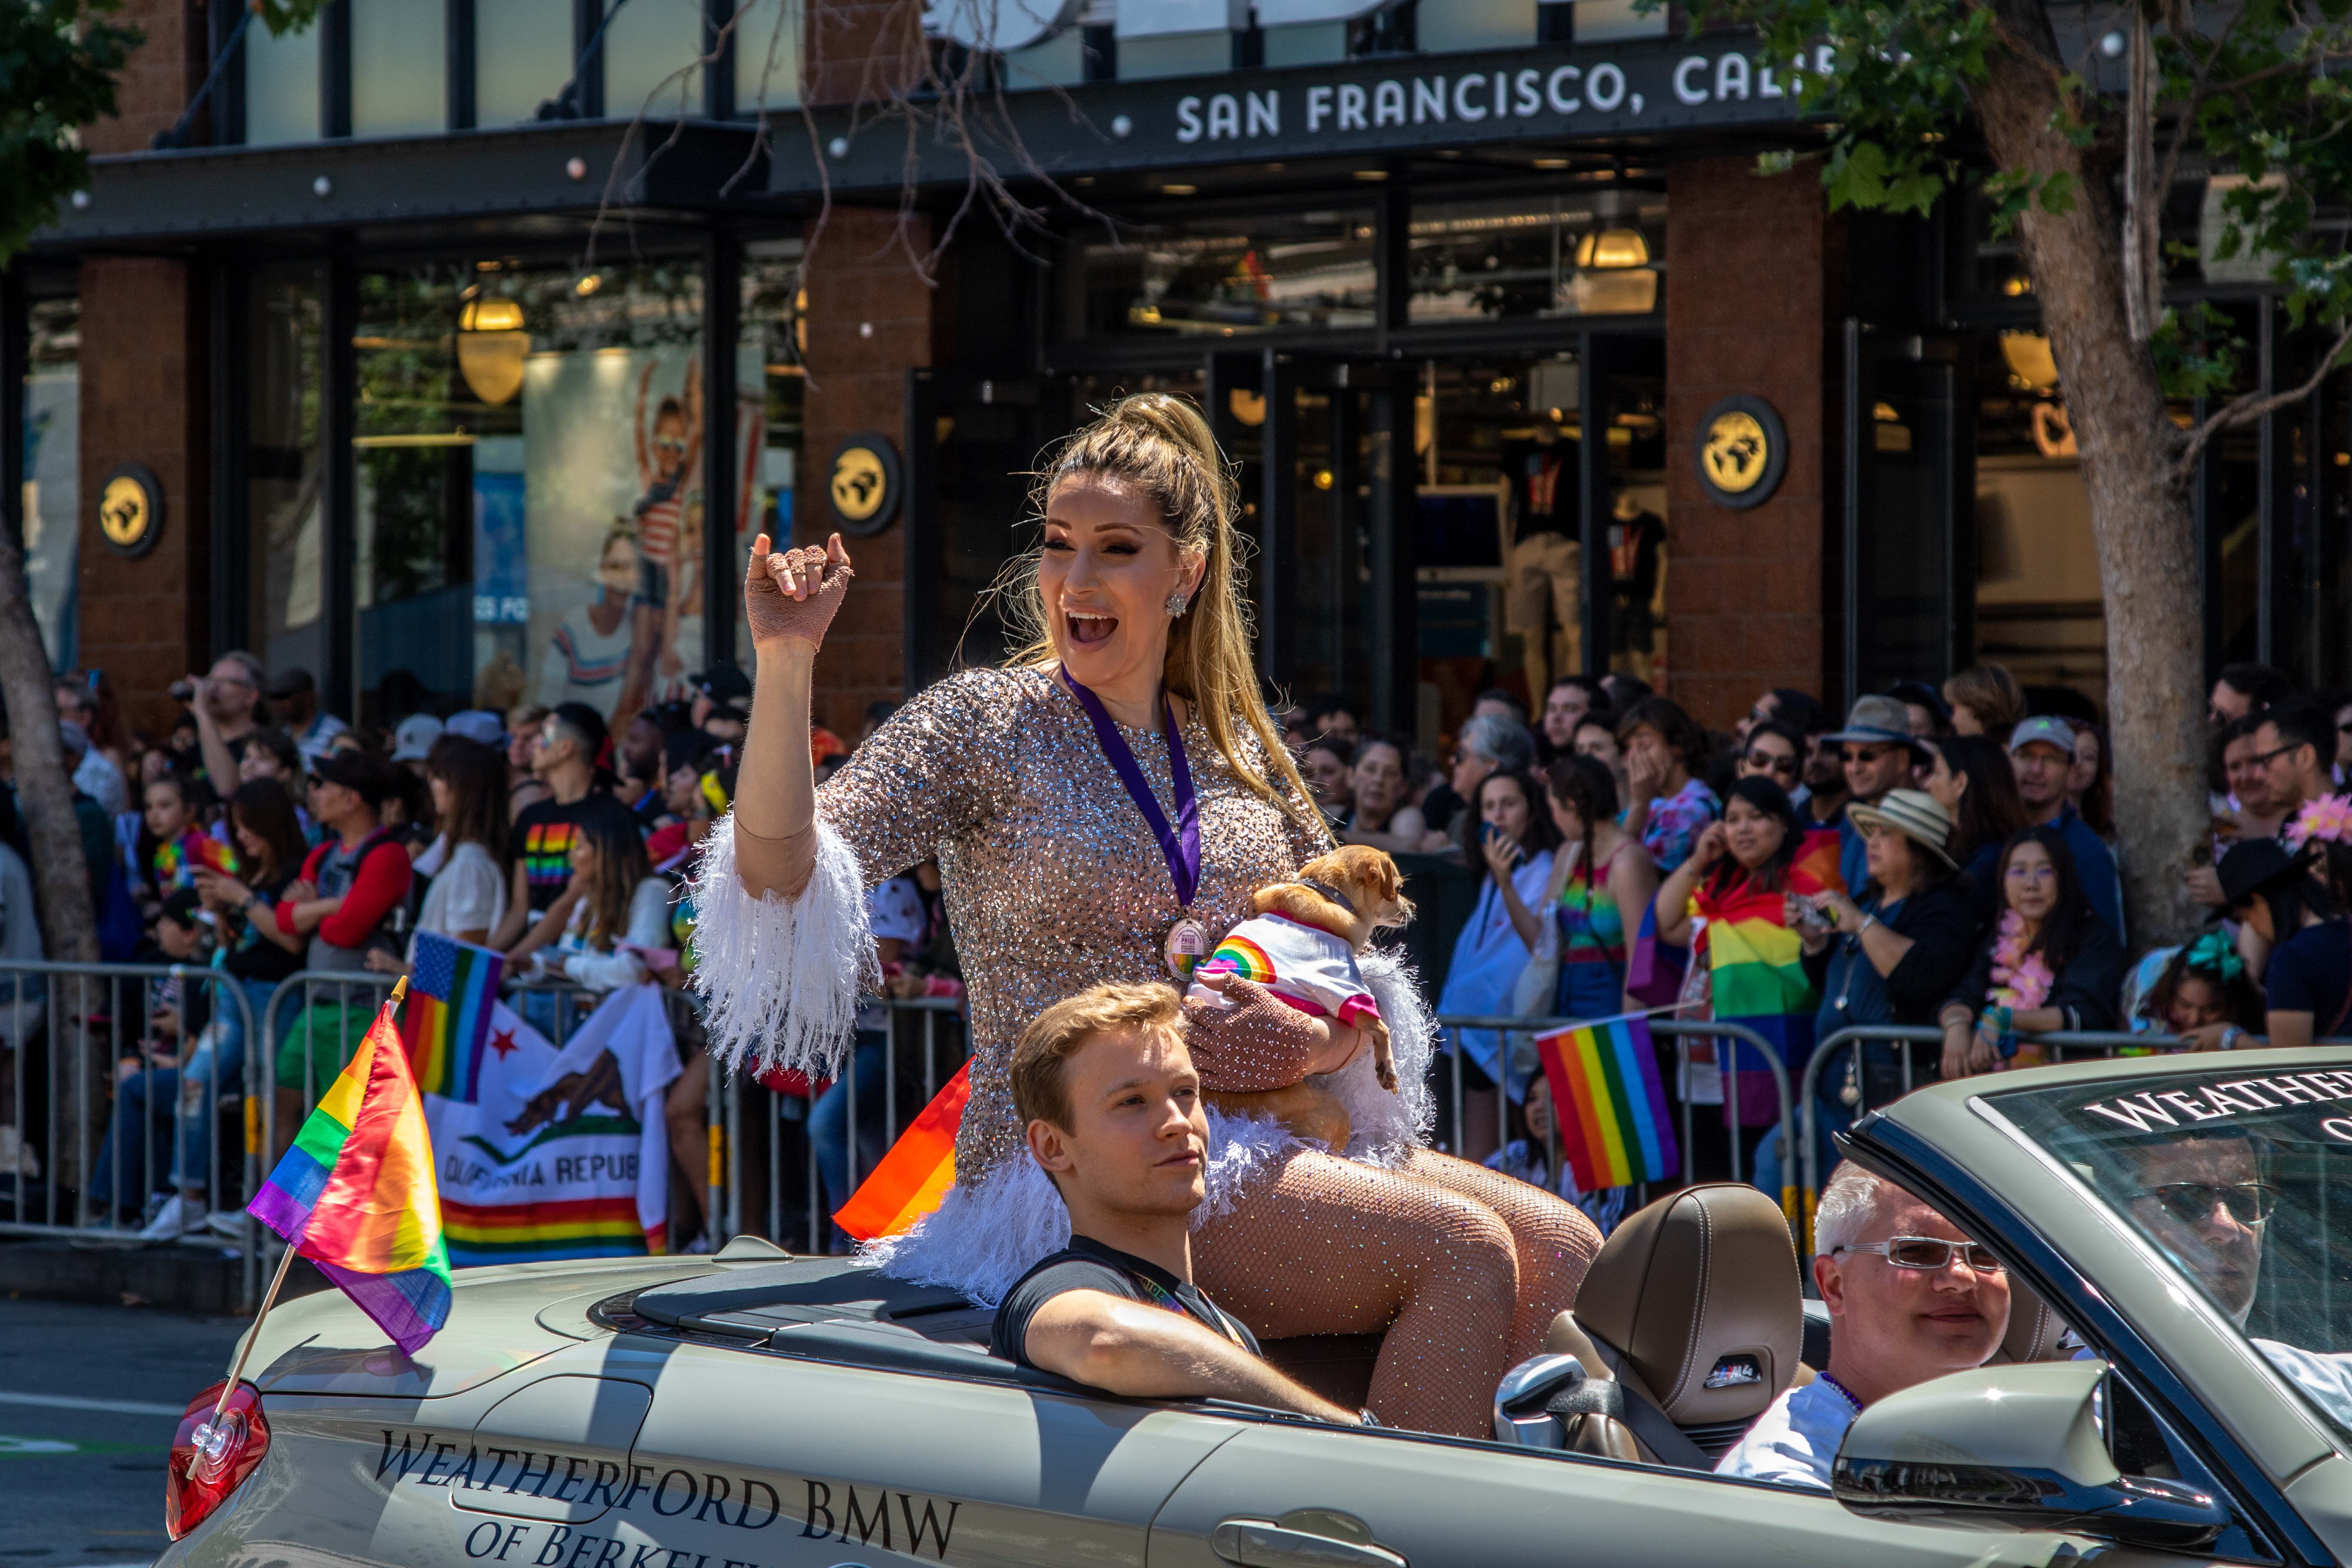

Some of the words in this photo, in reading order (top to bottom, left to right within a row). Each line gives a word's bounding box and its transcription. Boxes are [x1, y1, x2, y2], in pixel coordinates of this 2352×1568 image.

[1176, 90, 1280, 142] SAN
[1306, 63, 1645, 132] FRANCISCO,
[375, 1430, 780, 1529] WEATHERFORD
[797, 1479, 962, 1560] BMW
[465, 1522, 531, 1561] OF
[531, 1524, 779, 1568] BERKE
